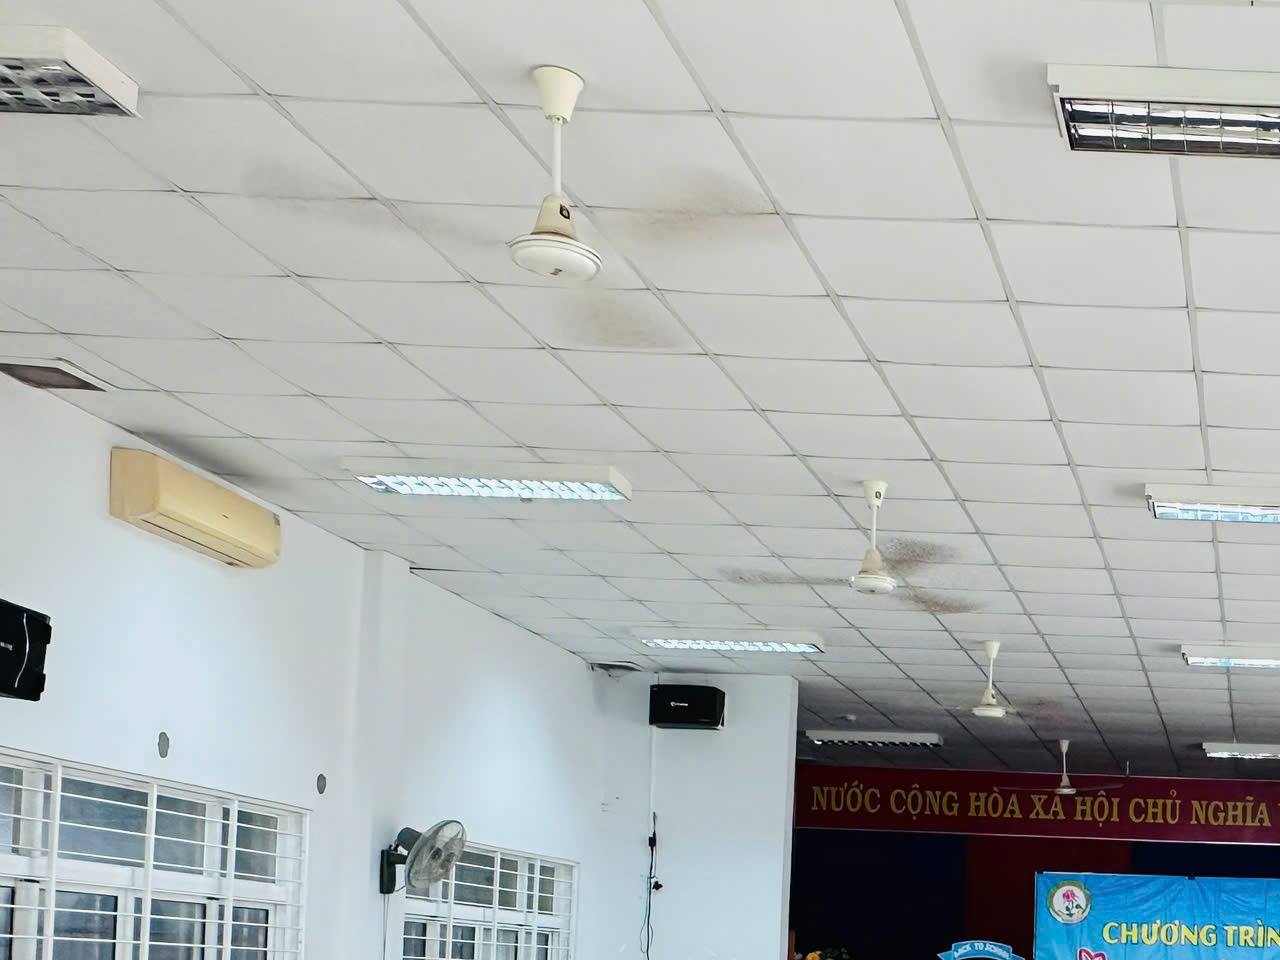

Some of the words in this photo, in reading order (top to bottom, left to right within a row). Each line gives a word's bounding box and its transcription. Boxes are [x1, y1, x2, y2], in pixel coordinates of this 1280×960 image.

[811, 780, 881, 814] NƯỚC
[890, 784, 959, 820] CỘNG
[968, 787, 1022, 819] HÒA
[1073, 790, 1120, 828] HỘI
[1129, 789, 1180, 825] CHỦ
[1190, 795, 1271, 827] NGHĨA
[1102, 920, 1217, 947] CHƯƠNG
